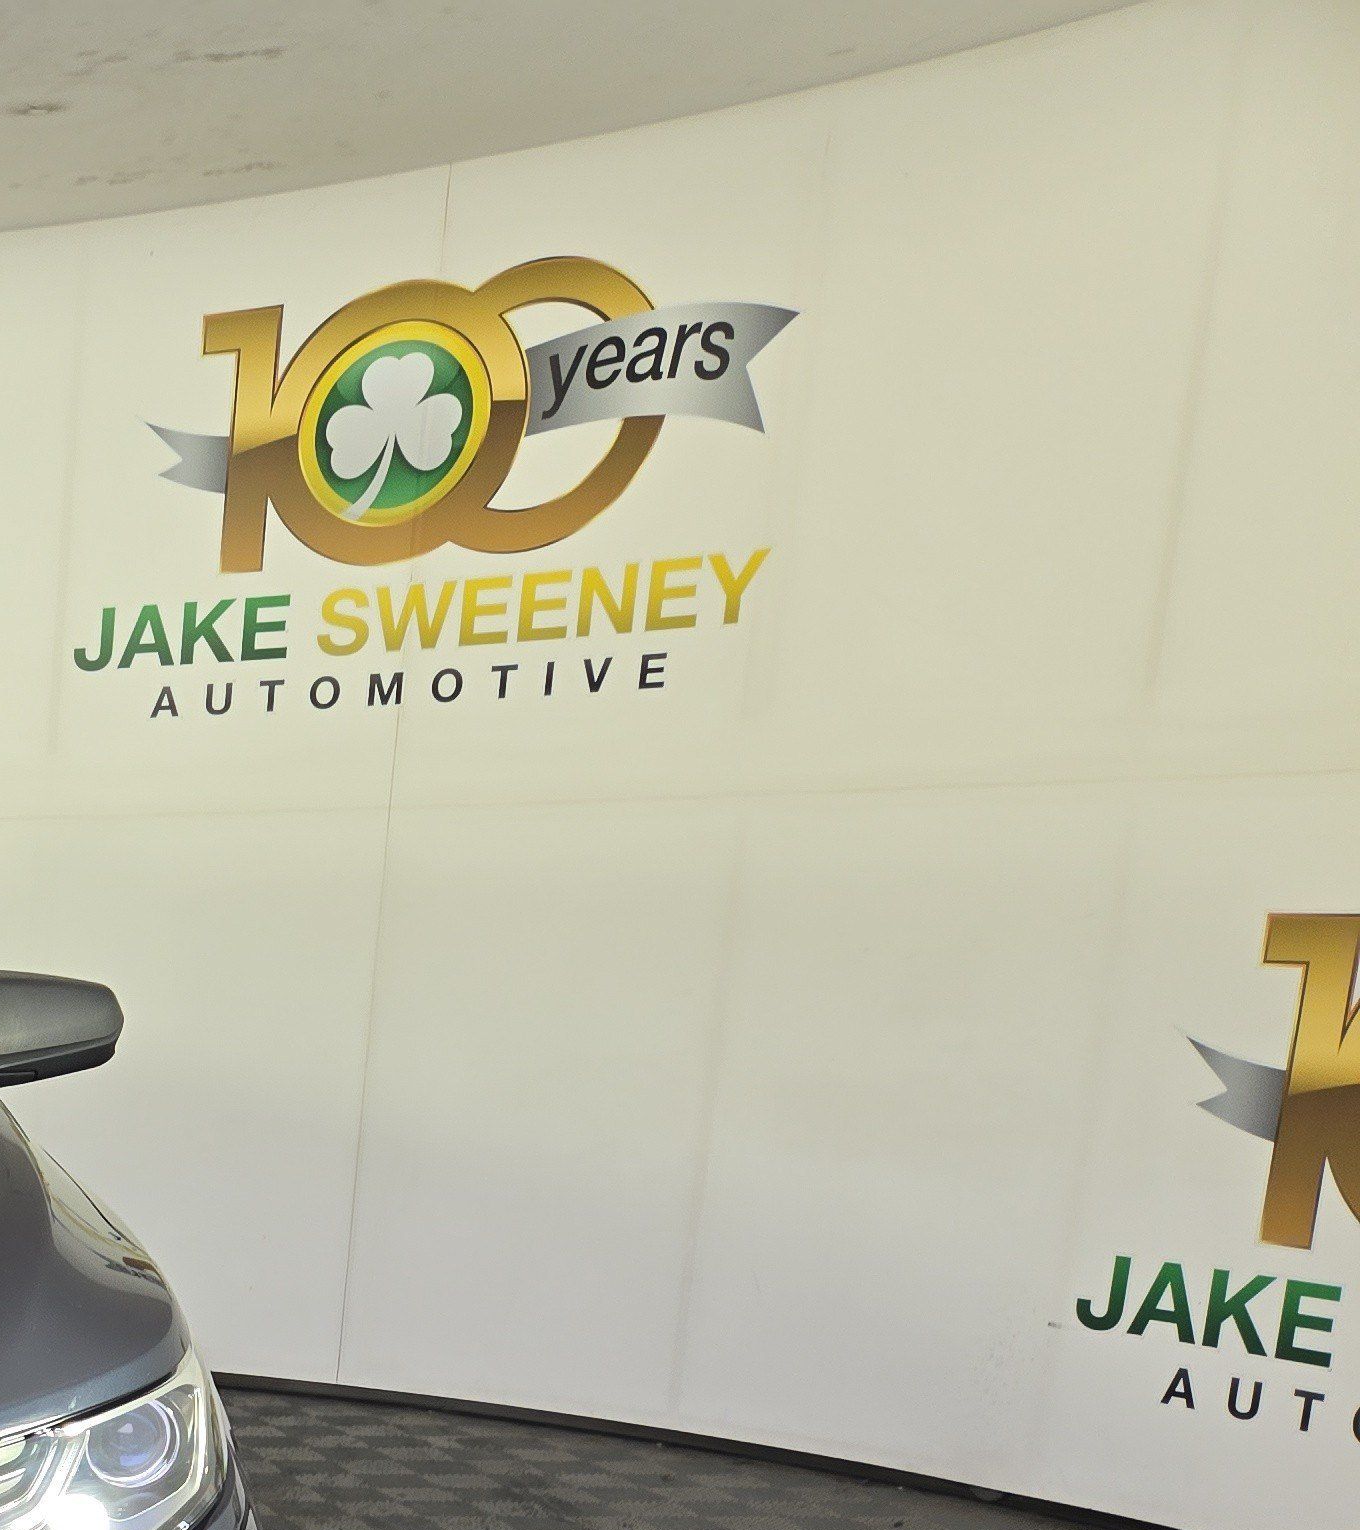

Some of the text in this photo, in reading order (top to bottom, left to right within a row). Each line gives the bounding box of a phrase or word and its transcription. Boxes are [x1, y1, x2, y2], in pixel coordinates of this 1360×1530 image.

[202, 256, 664, 573] 100
[541, 318, 736, 420] years
[73, 547, 771, 672] JAKE SWEENEY
[150, 652, 668, 719] AUTOMOTIVE
[1076, 1255, 1342, 1369] JAKE
[1161, 1367, 1360, 1443] AUT
